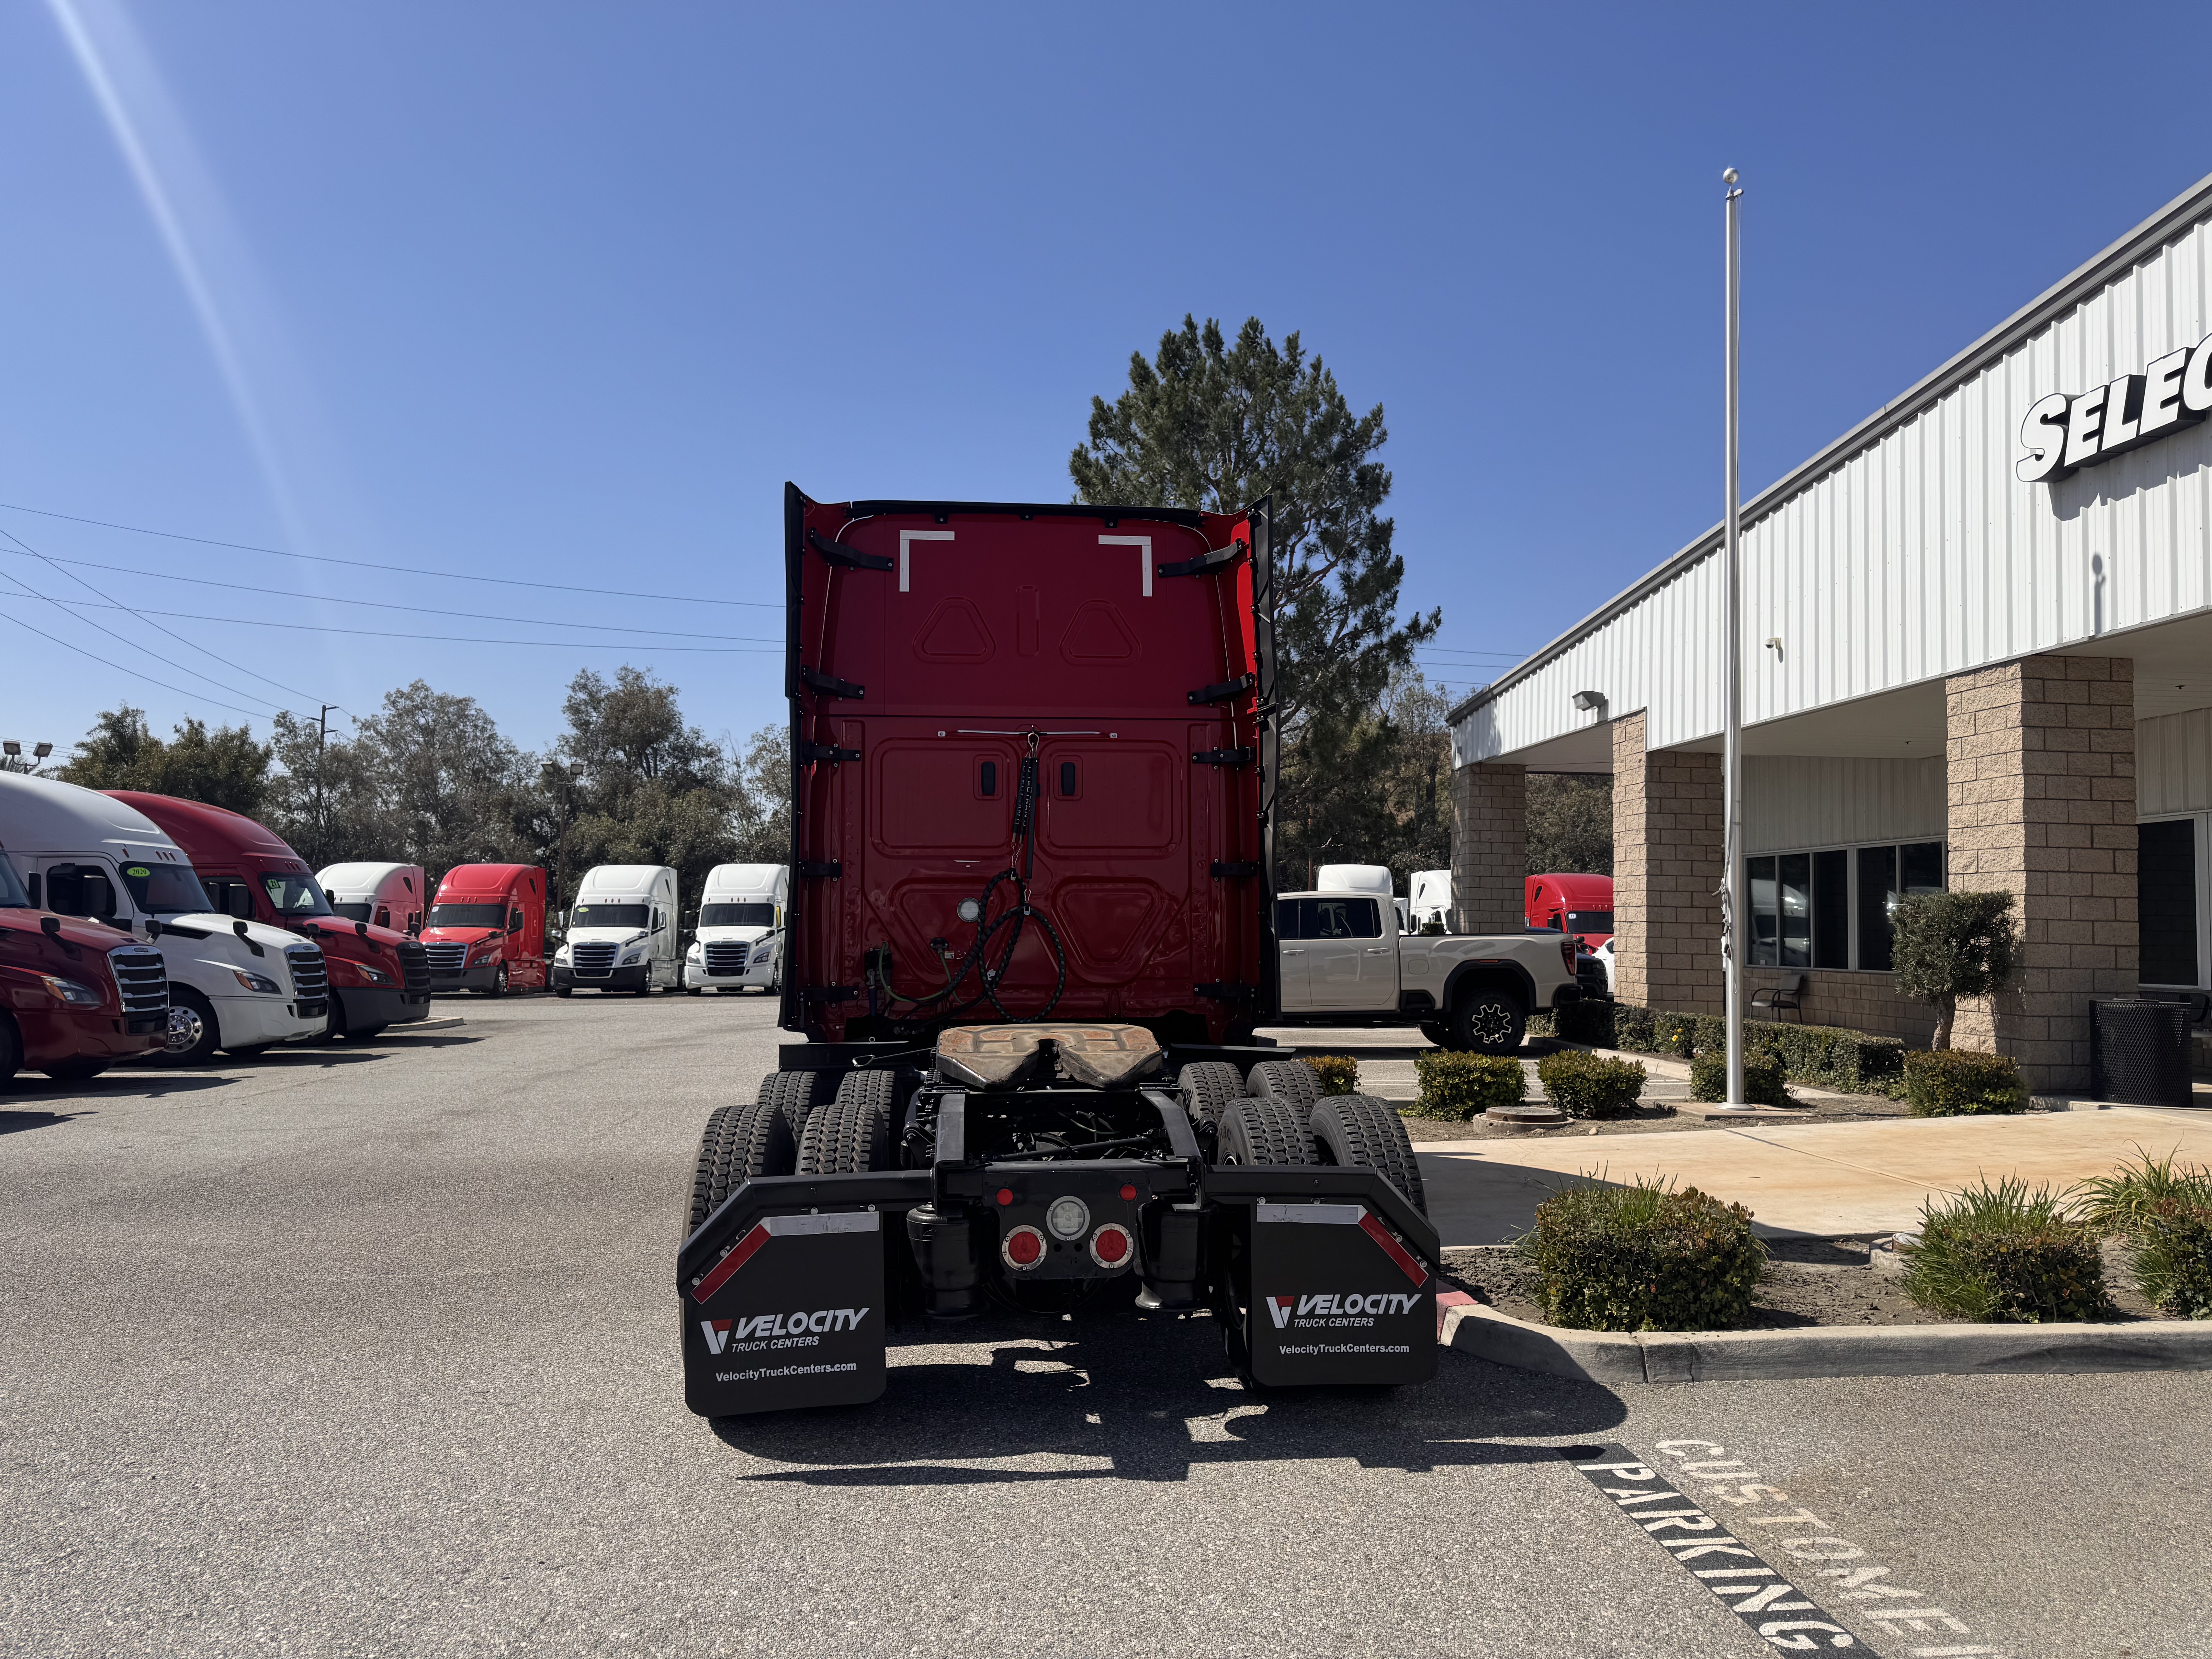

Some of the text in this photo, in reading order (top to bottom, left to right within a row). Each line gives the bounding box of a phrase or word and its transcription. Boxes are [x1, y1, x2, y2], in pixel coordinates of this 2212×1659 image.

[1297, 1294, 1422, 1315] VELOCITY
[735, 1308, 870, 1339] VELOCITY
[1294, 1317, 1374, 1328] TRUCK CENTERS
[732, 1336, 819, 1352] TRUCK CENTERS
[1279, 1343, 1410, 1355] VelocityTruckCenters.com
[716, 1362, 857, 1382] VelocityTruckCenters.com
[1576, 1462, 1853, 1649] PARKING
